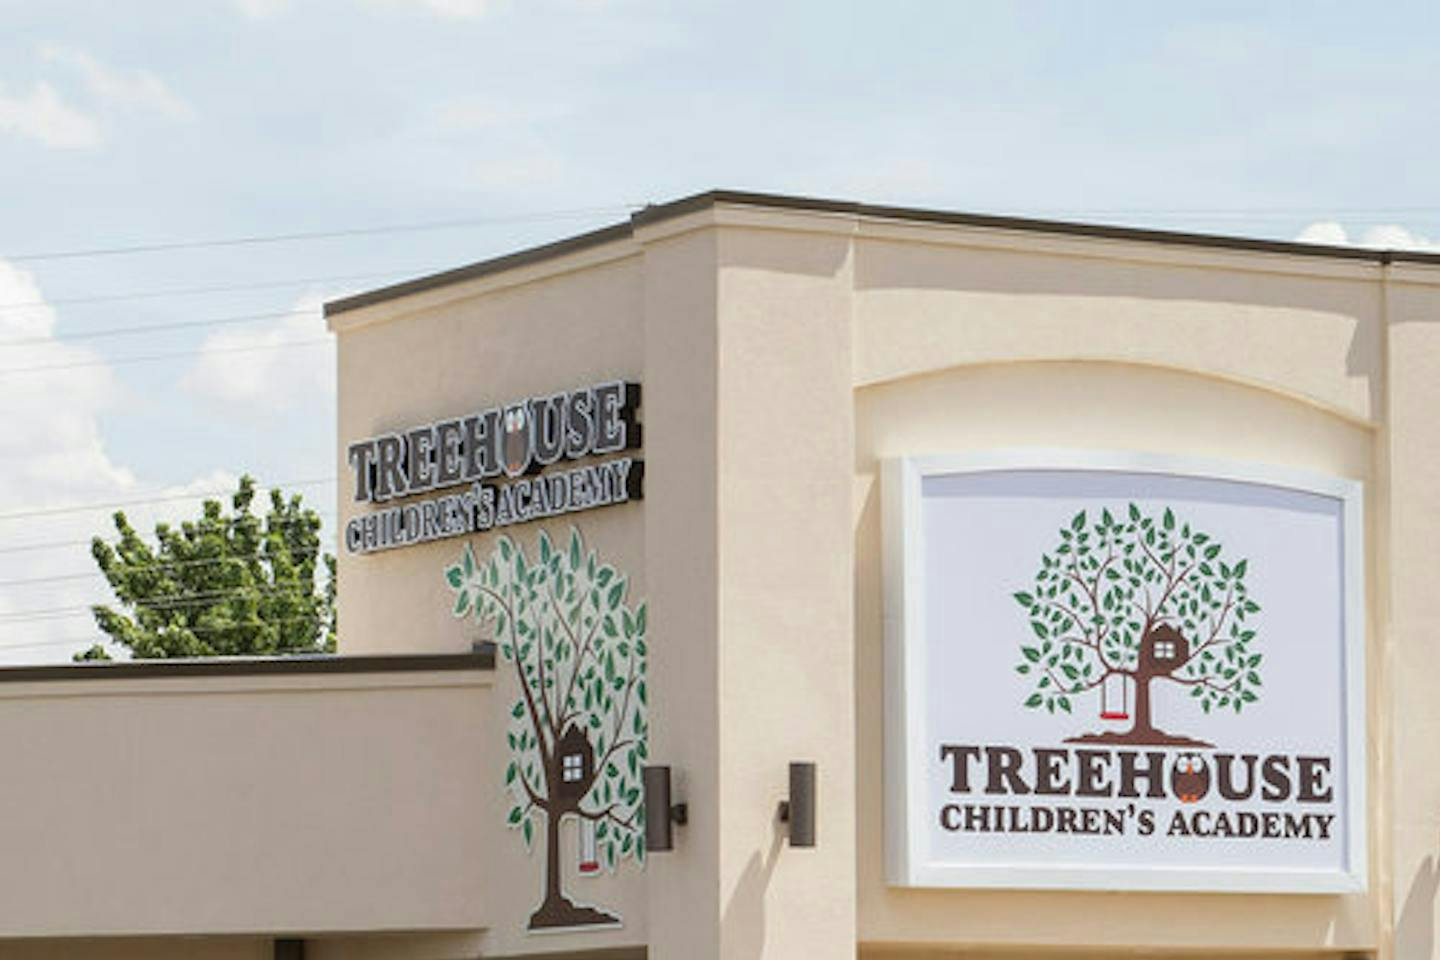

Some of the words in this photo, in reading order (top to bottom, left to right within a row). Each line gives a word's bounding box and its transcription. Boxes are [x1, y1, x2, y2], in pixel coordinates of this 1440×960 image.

[347, 379, 633, 503] TREEHOUSE
[496, 458, 635, 527] ACADEMY
[940, 745, 1333, 803] TREEHOUSE
[939, 803, 1156, 836] CHILDREN'S
[1166, 810, 1336, 839] ACADEMY
